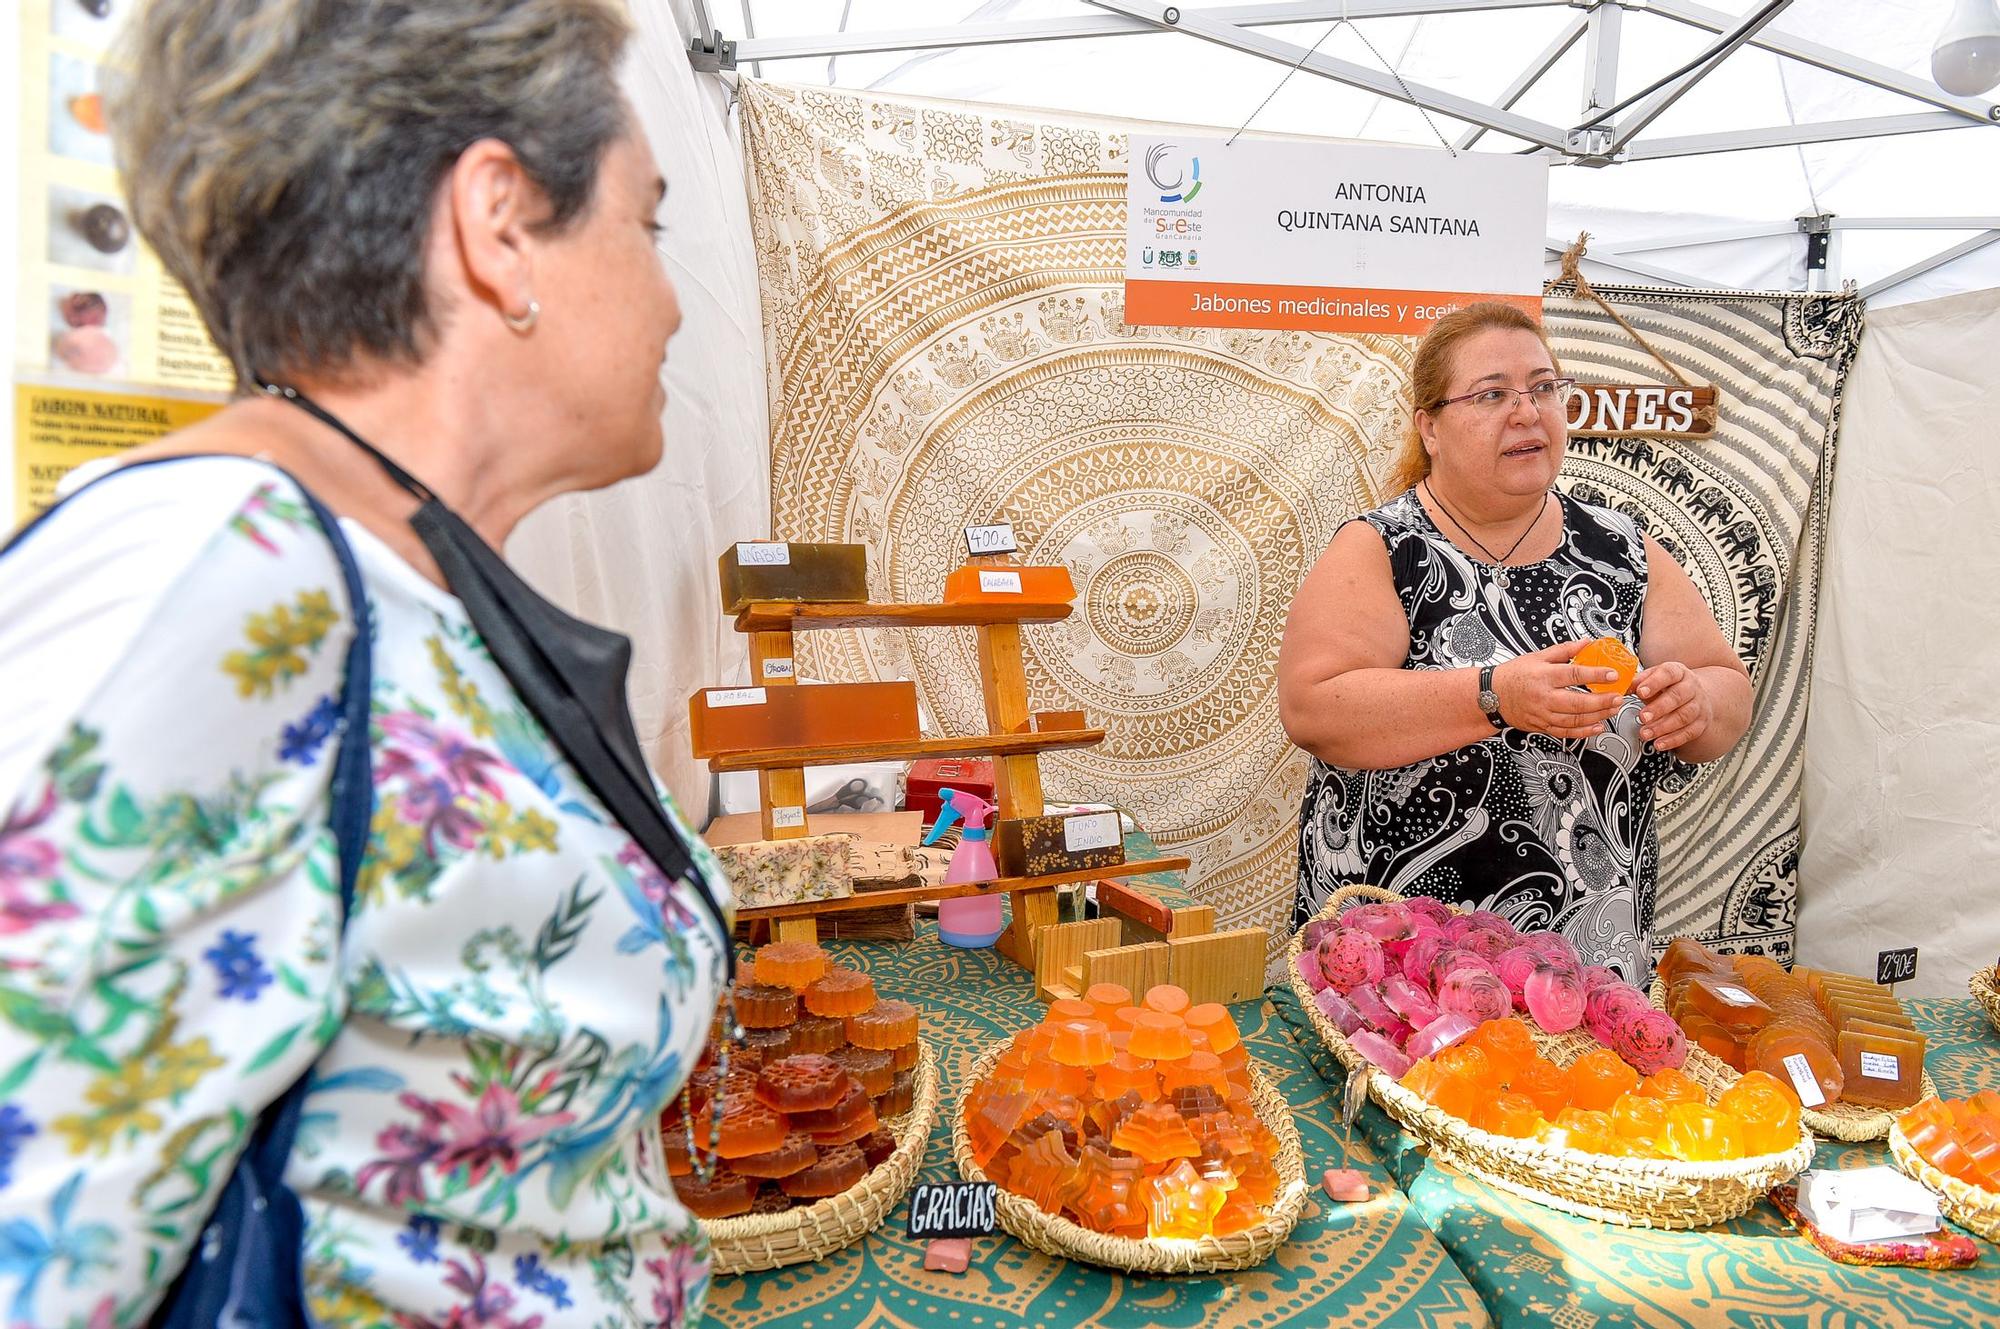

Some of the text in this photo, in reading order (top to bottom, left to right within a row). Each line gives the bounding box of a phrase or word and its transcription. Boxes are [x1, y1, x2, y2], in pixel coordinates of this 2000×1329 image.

[1335, 182, 1427, 204] ANTONIA
[1143, 207, 1203, 218] Mancomunidad
[1277, 210, 1481, 237] QUINTANA SANTANA
[1191, 293, 1272, 314] Jabones
[1278, 296, 1391, 319] medicinales
[1396, 305, 1408, 322] y
